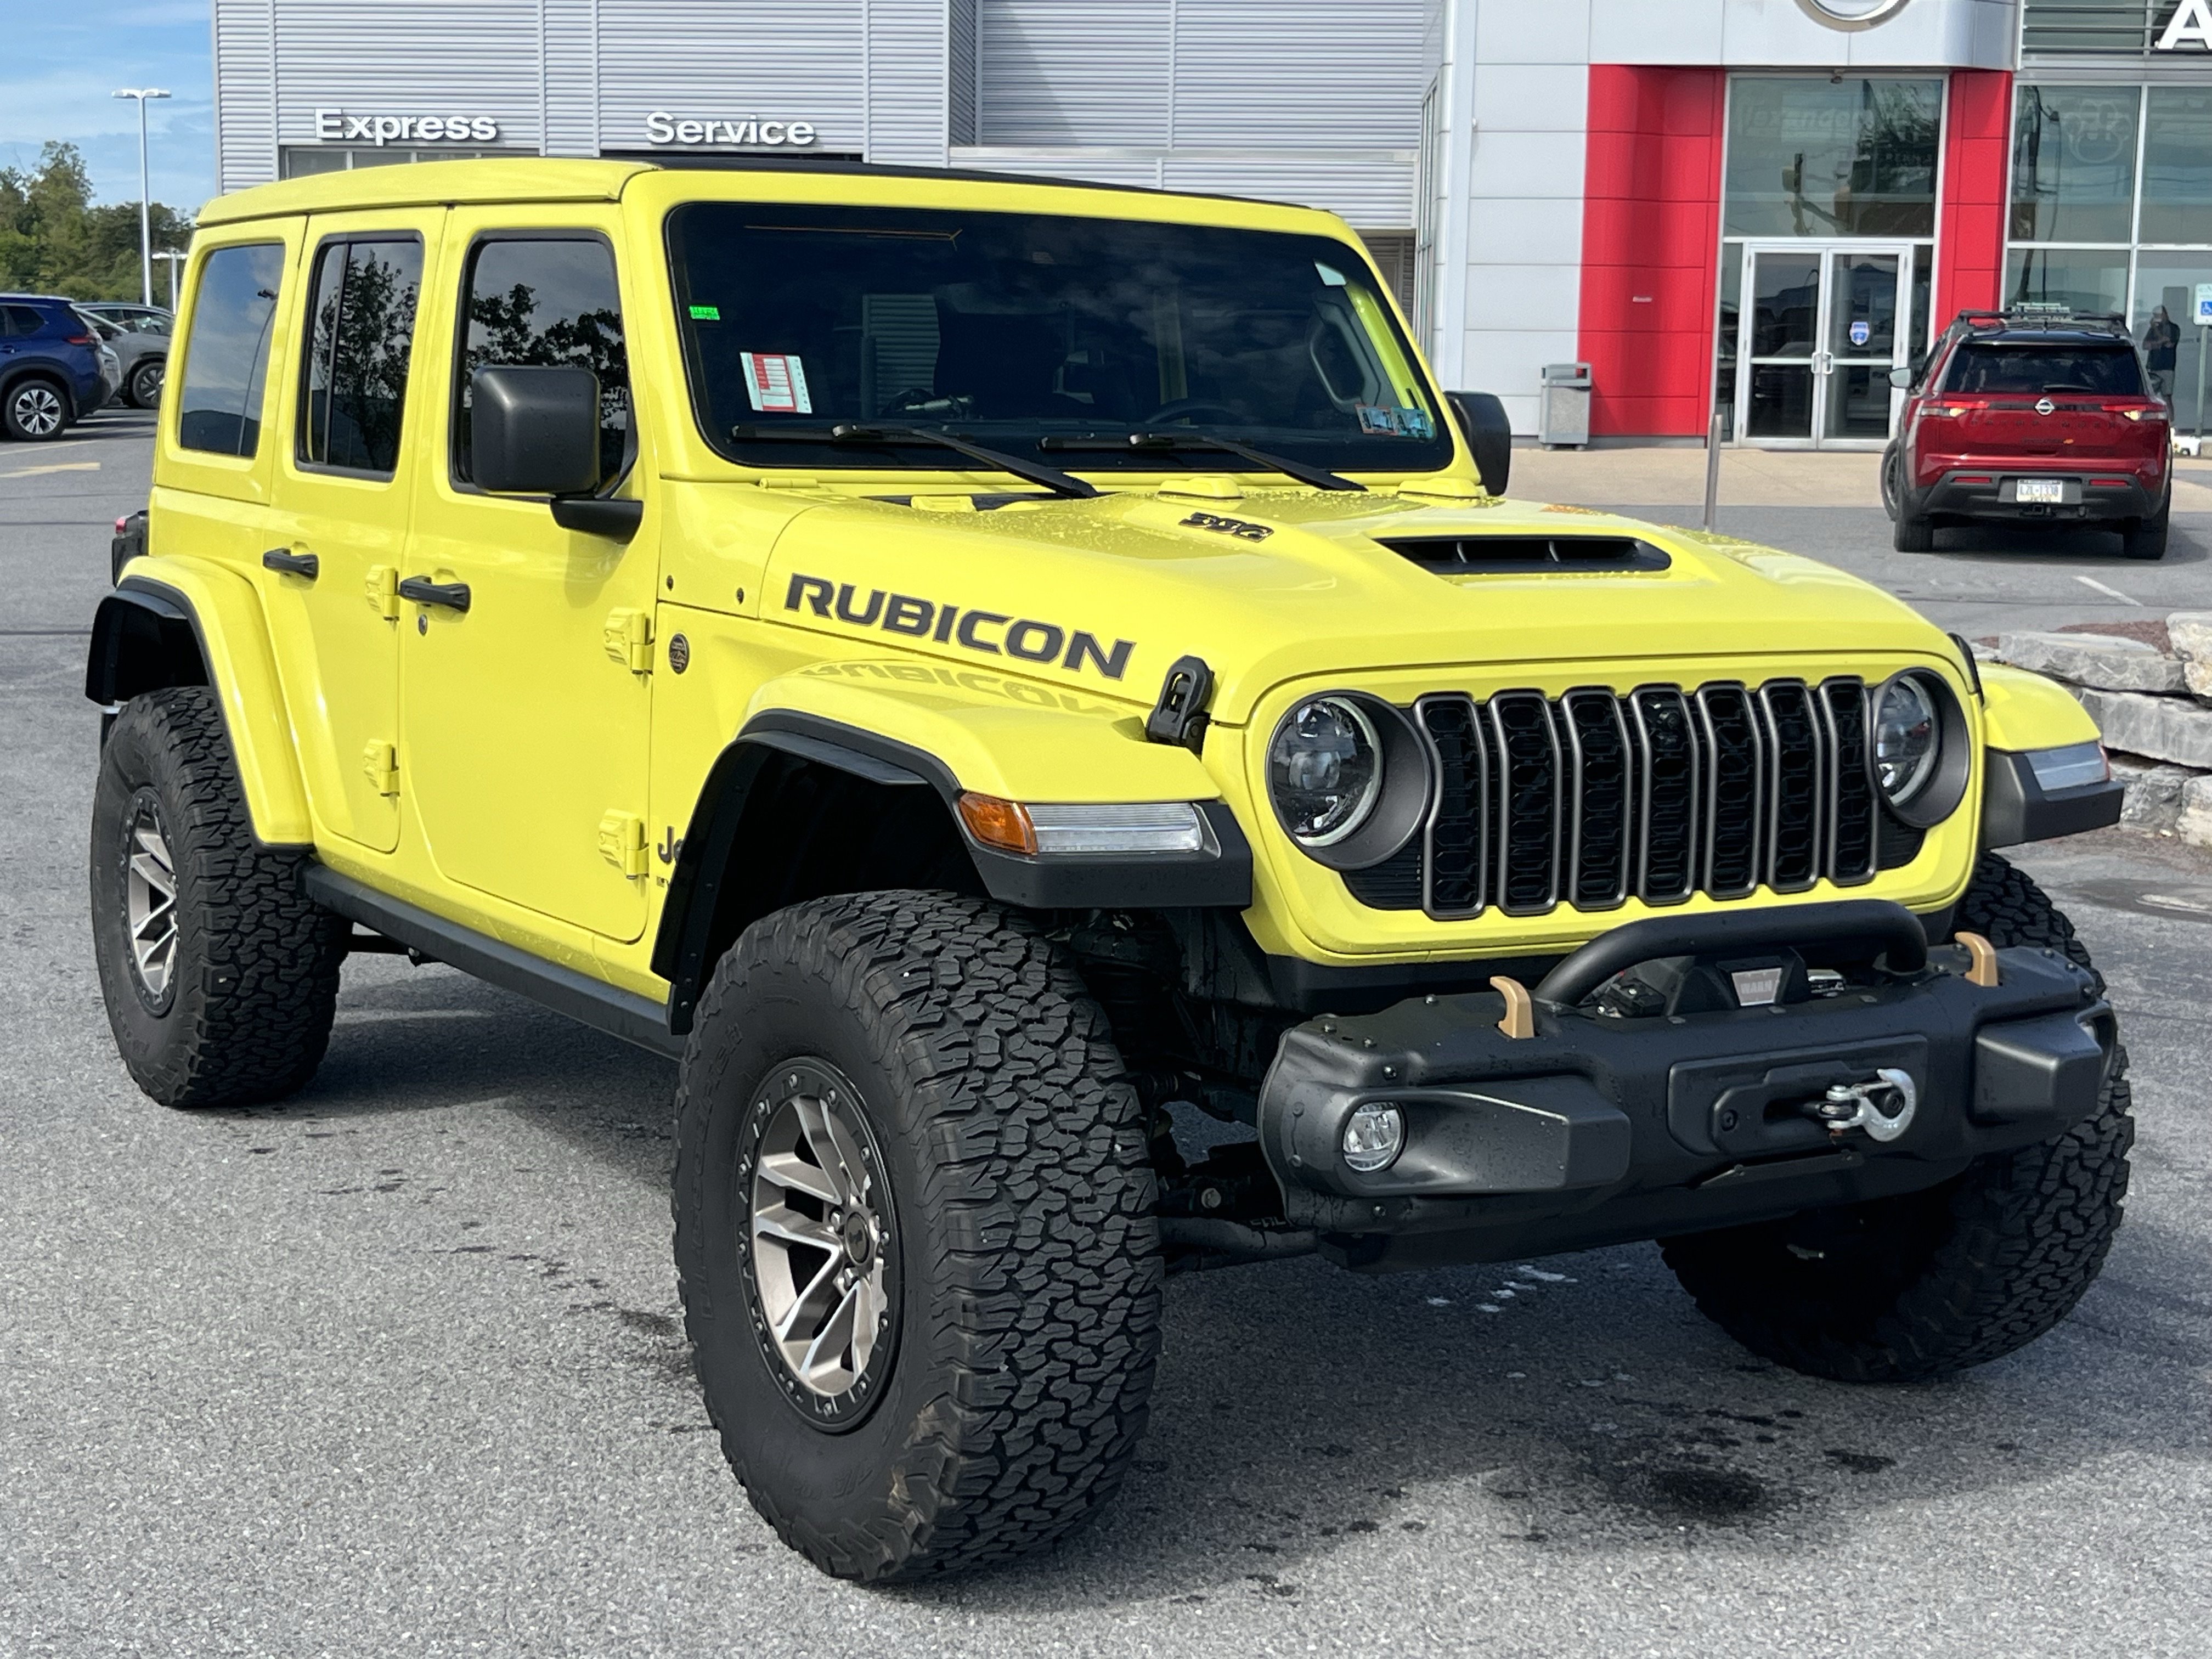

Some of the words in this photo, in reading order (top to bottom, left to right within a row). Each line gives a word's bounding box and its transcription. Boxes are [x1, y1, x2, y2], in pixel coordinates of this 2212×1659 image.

[315, 109, 496, 146] Express
[645, 111, 815, 145] Service
[1178, 512, 1274, 543] 392
[784, 573, 1137, 681] RUBICON
